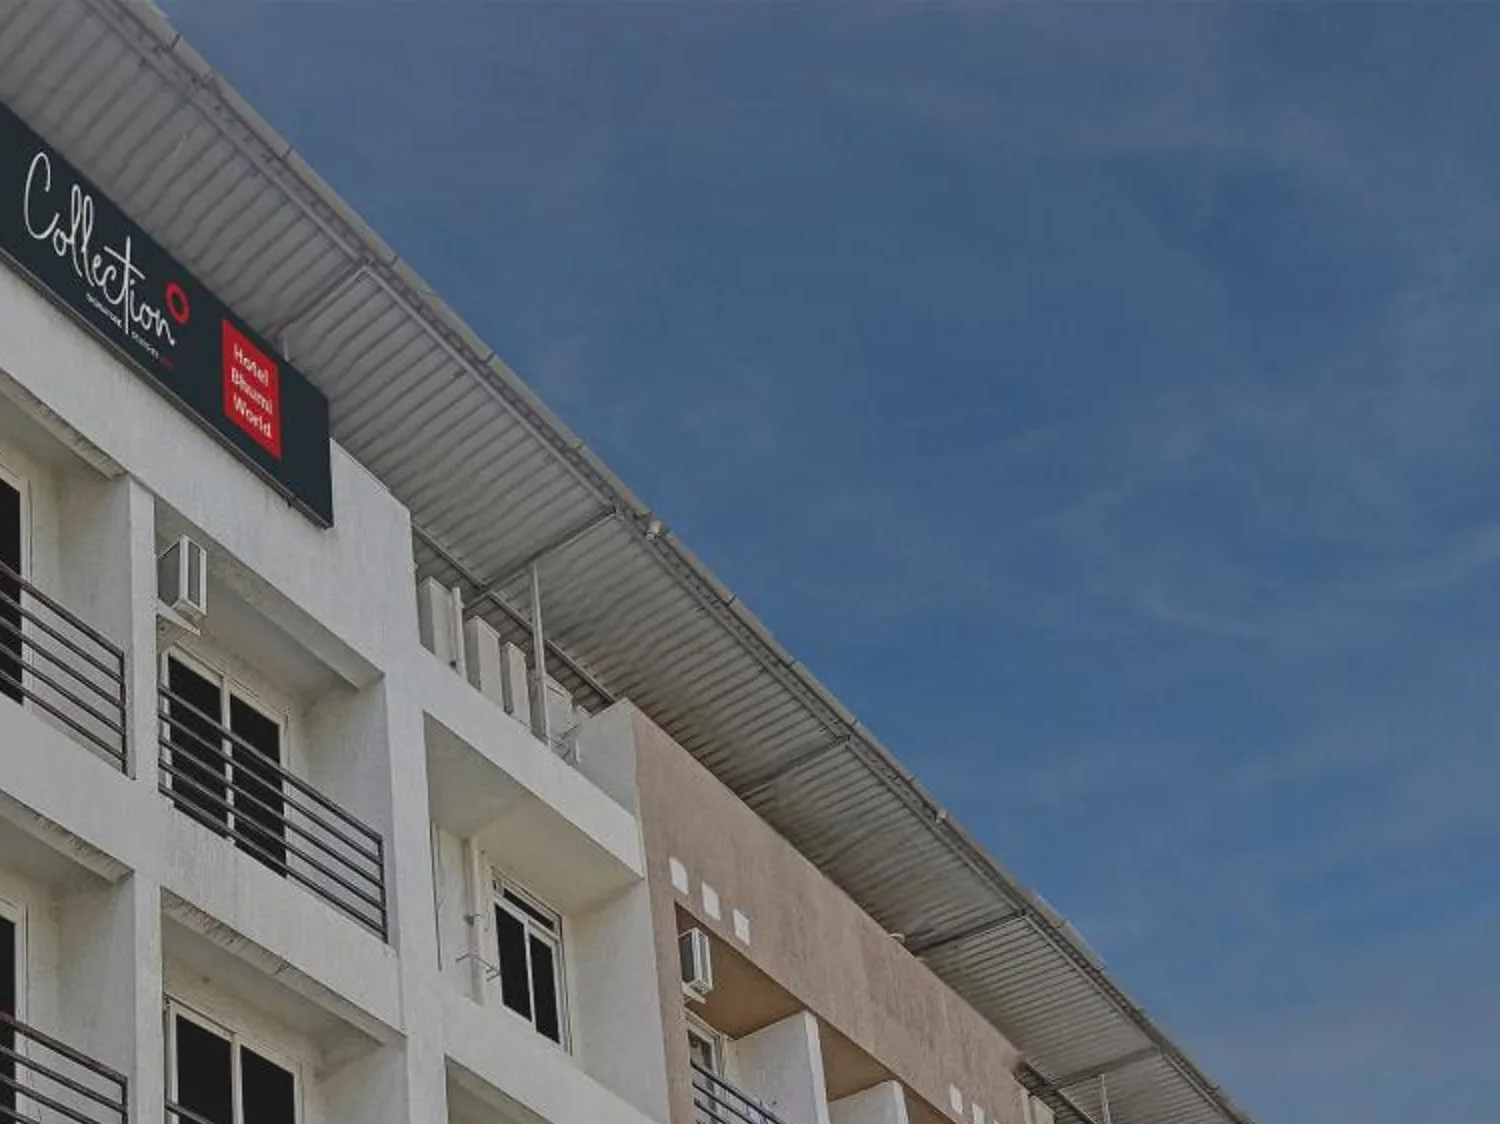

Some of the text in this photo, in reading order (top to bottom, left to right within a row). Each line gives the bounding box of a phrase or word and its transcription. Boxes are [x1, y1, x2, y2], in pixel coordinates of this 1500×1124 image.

[24, 152, 176, 345] Collection
[233, 342, 269, 387] Hotel
[233, 391, 273, 440] World
